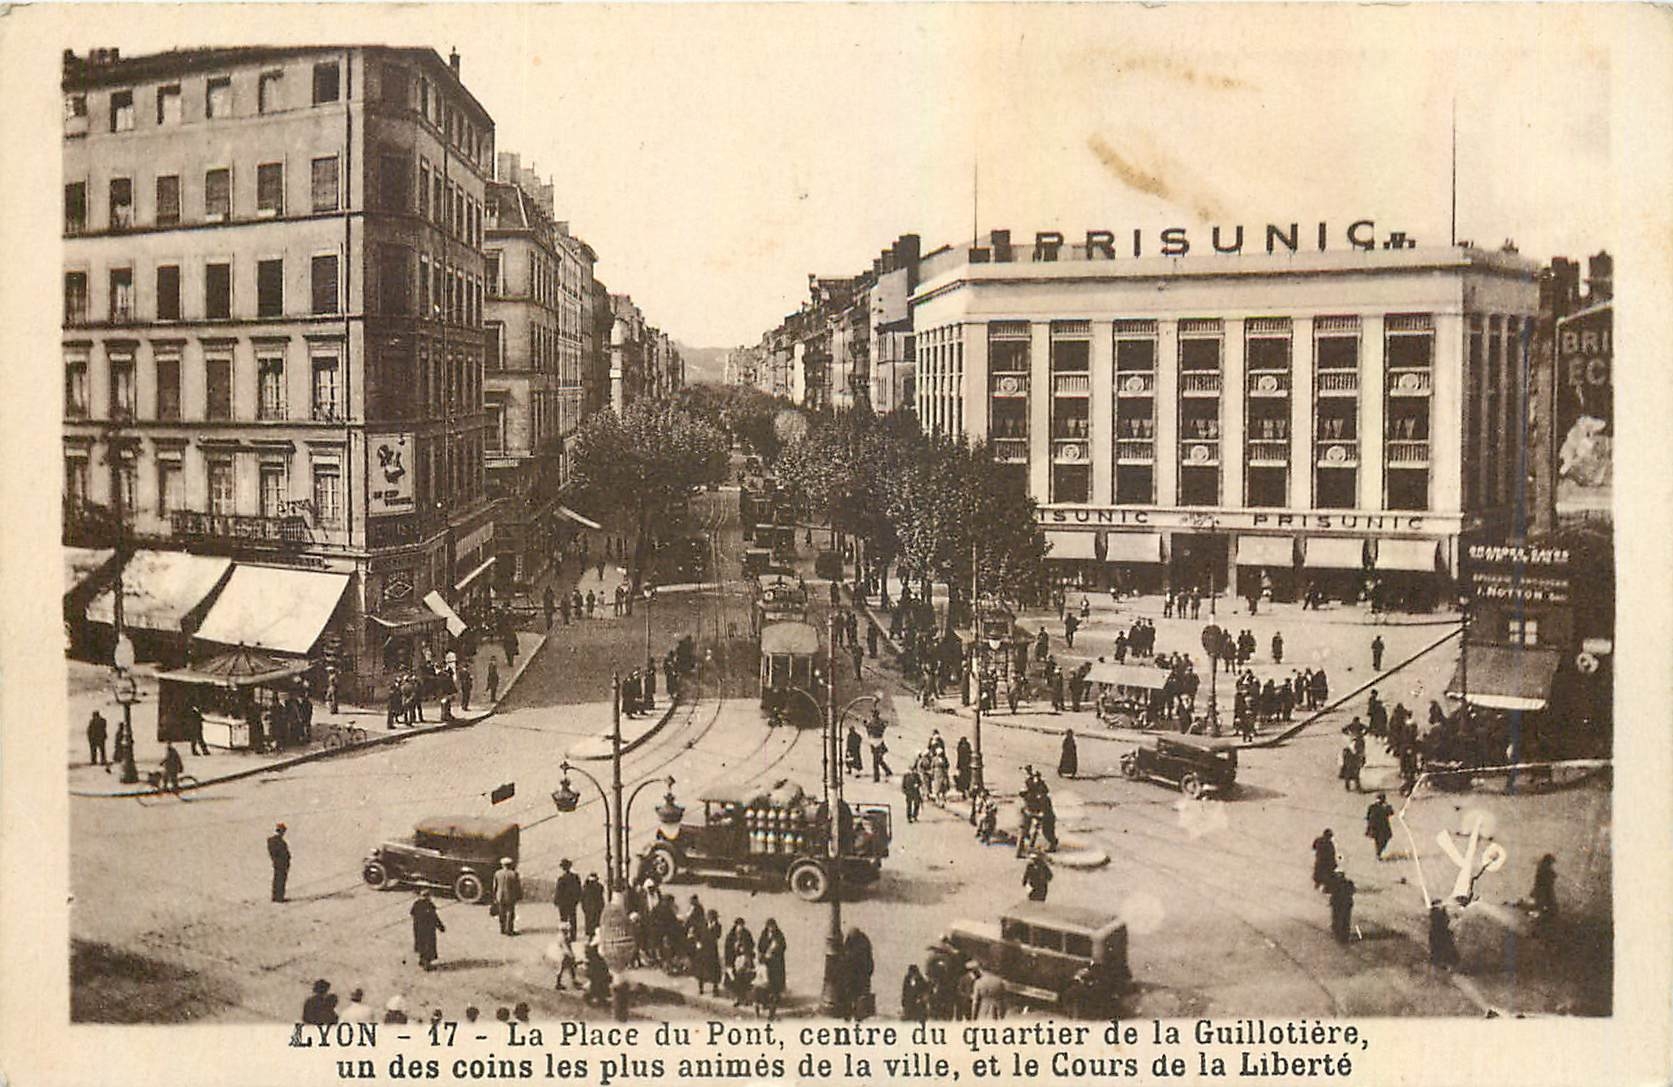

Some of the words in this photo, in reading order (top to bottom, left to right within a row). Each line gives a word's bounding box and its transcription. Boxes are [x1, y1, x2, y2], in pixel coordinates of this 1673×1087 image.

[1034, 220, 1375, 262] PRISUNIC
[1040, 509, 1149, 524] ISUNIC
[1253, 513, 1424, 530] PRISUNIC
